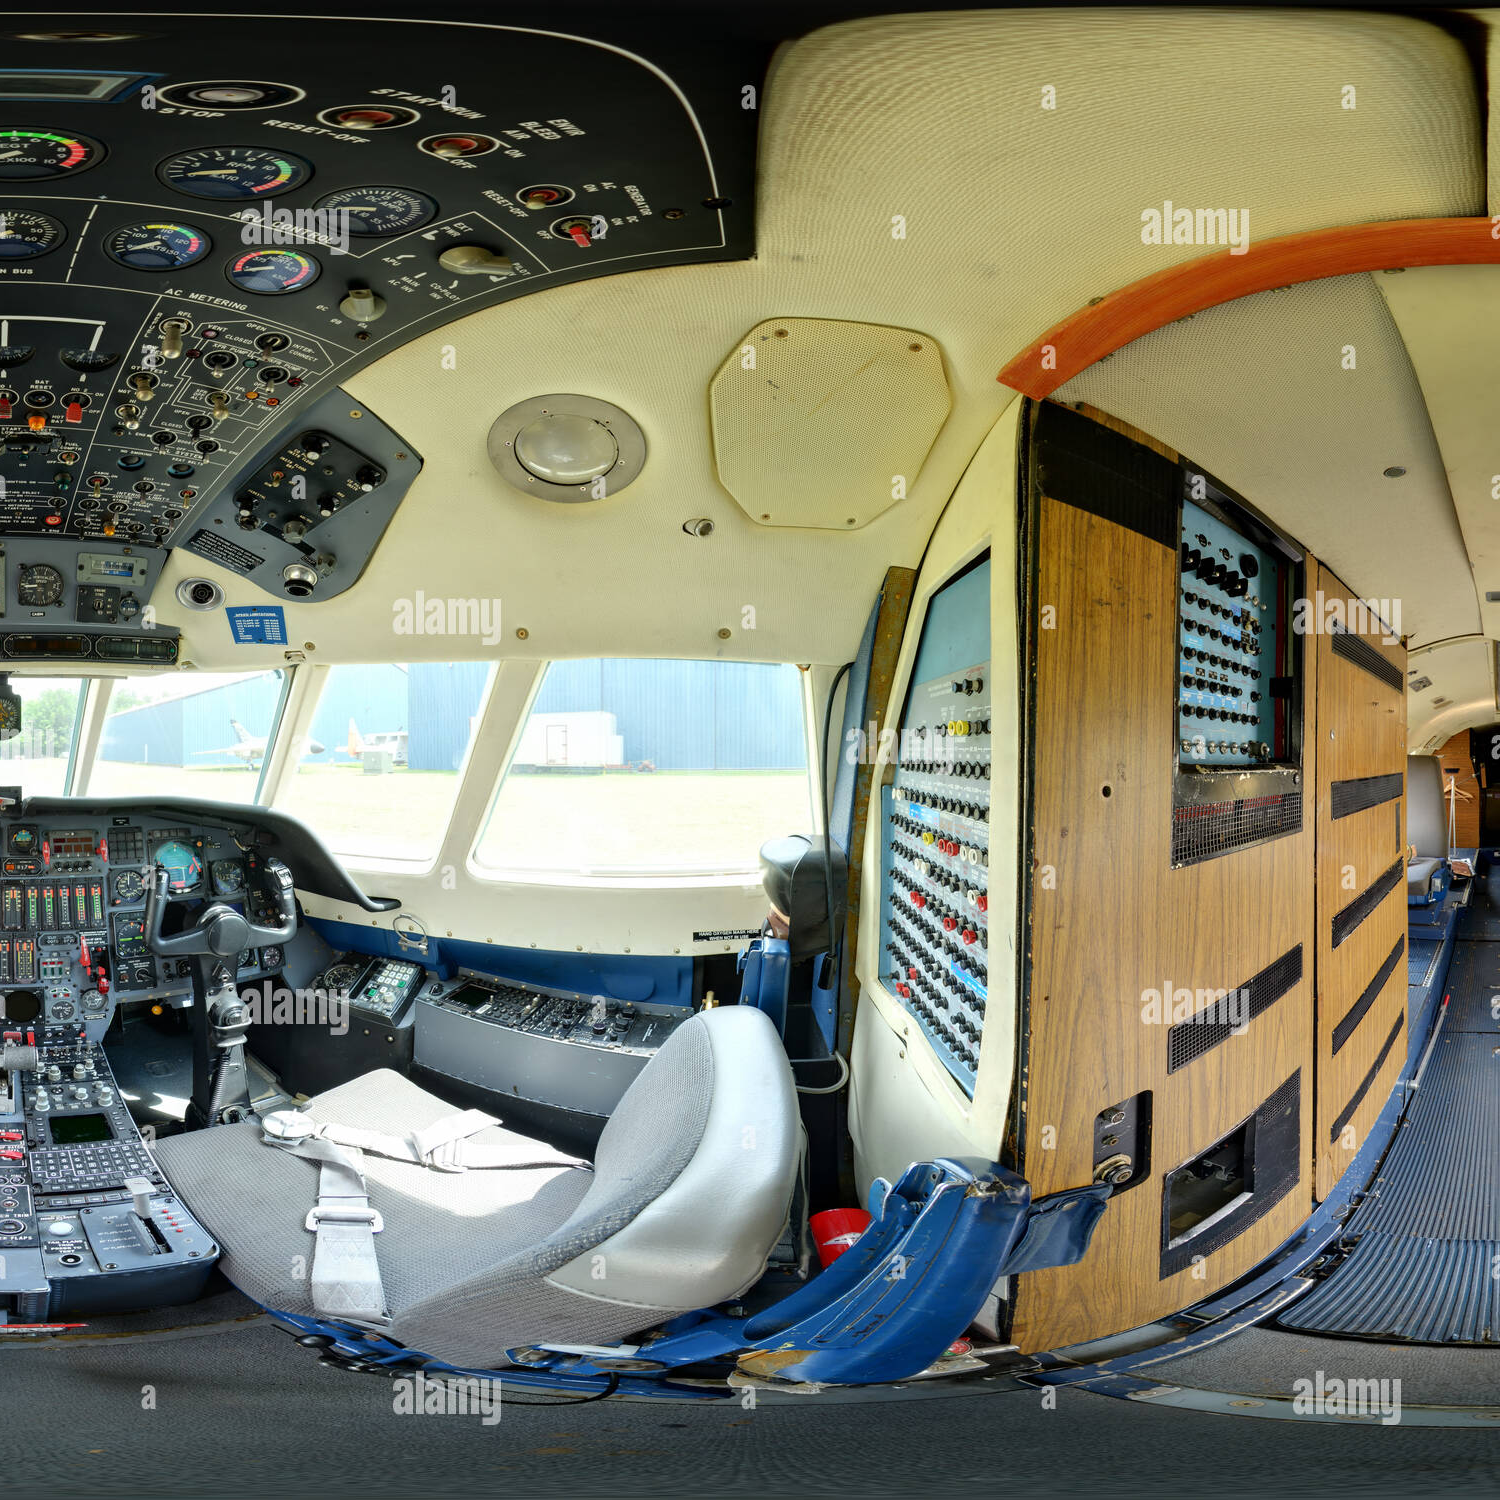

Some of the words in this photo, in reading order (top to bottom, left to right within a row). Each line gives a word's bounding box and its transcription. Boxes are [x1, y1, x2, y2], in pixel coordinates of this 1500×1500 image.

[158, 107, 226, 118] STOP
[262, 119, 372, 145] RESET-OFF
[501, 128, 532, 141] AIR
[517, 121, 562, 140] BLEED
[504, 149, 527, 159] ON
[226, 161, 256, 170] RPM
[450, 158, 478, 170] OFF
[582, 183, 600, 193] ON
[600, 181, 617, 190] AC
[482, 189, 530, 219] RESET-OFF
[623, 184, 653, 217] GENERATOR
[229, 211, 265, 224] APU
[271, 219, 334, 244] CONTROL
[440, 225, 461, 238] PWR
[452, 222, 474, 233] EXT
[536, 230, 553, 240] OFF
[381, 256, 402, 266] APU
[512, 262, 531, 277] PILOT
[388, 279, 400, 287] AC
[401, 285, 415, 293] INV
[401, 276, 422, 287] MAIN
[430, 282, 461, 302] CO-PILOT
[164, 288, 183, 297] AC
[188, 292, 249, 312] METERING
[207, 324, 228, 333] VENT
[246, 322, 267, 332] OPEN
[224, 334, 253, 345] CLOSED
[289, 350, 319, 362] CONNECT
